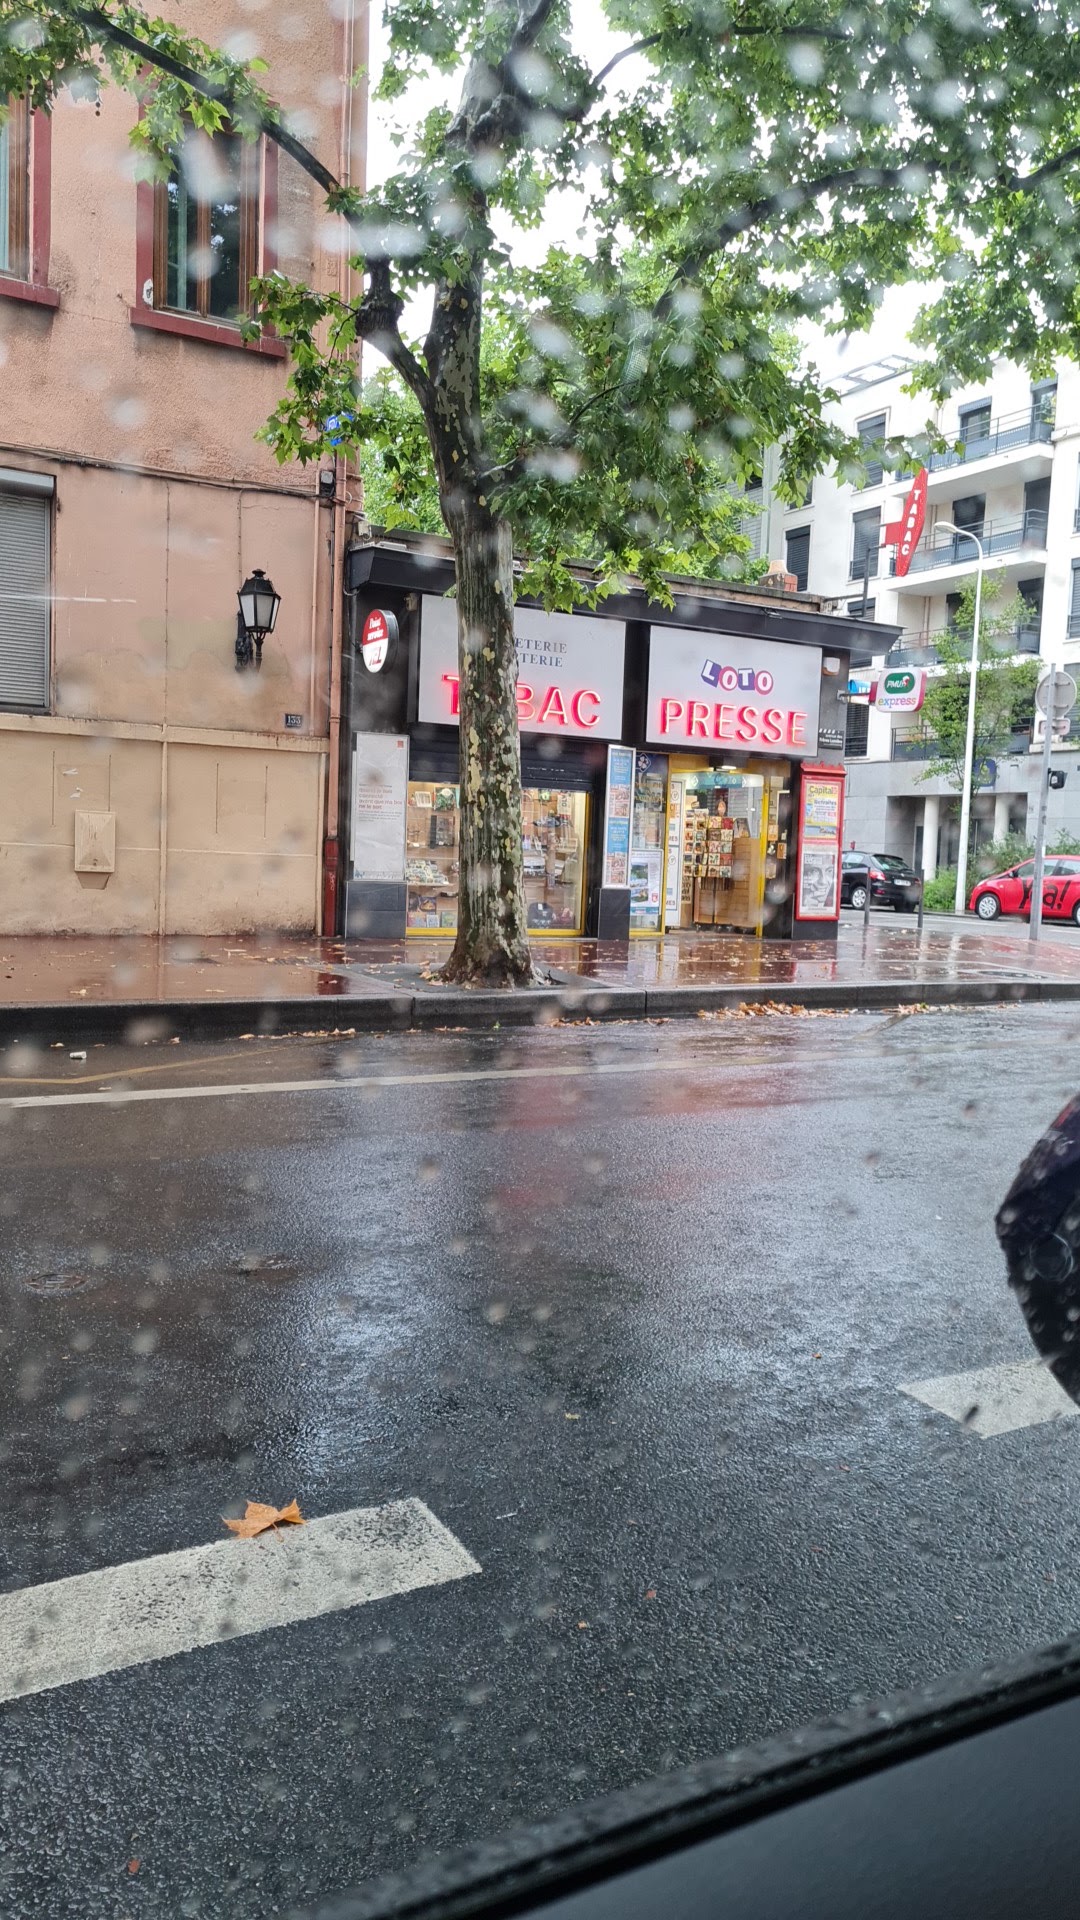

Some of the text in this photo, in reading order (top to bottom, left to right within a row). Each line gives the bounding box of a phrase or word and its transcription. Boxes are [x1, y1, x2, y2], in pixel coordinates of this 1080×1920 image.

[901, 489, 922, 556] TABAC
[514, 637, 567, 654] ETERIE
[701, 659, 774, 695] LOTO
[886, 680, 902, 688] PMU
[441, 673, 601, 729] TBAC
[878, 697, 917, 708] express
[660, 698, 808, 746] PRESSE
[809, 785, 834, 796] Capital
[1018, 878, 1072, 910] Ya!
